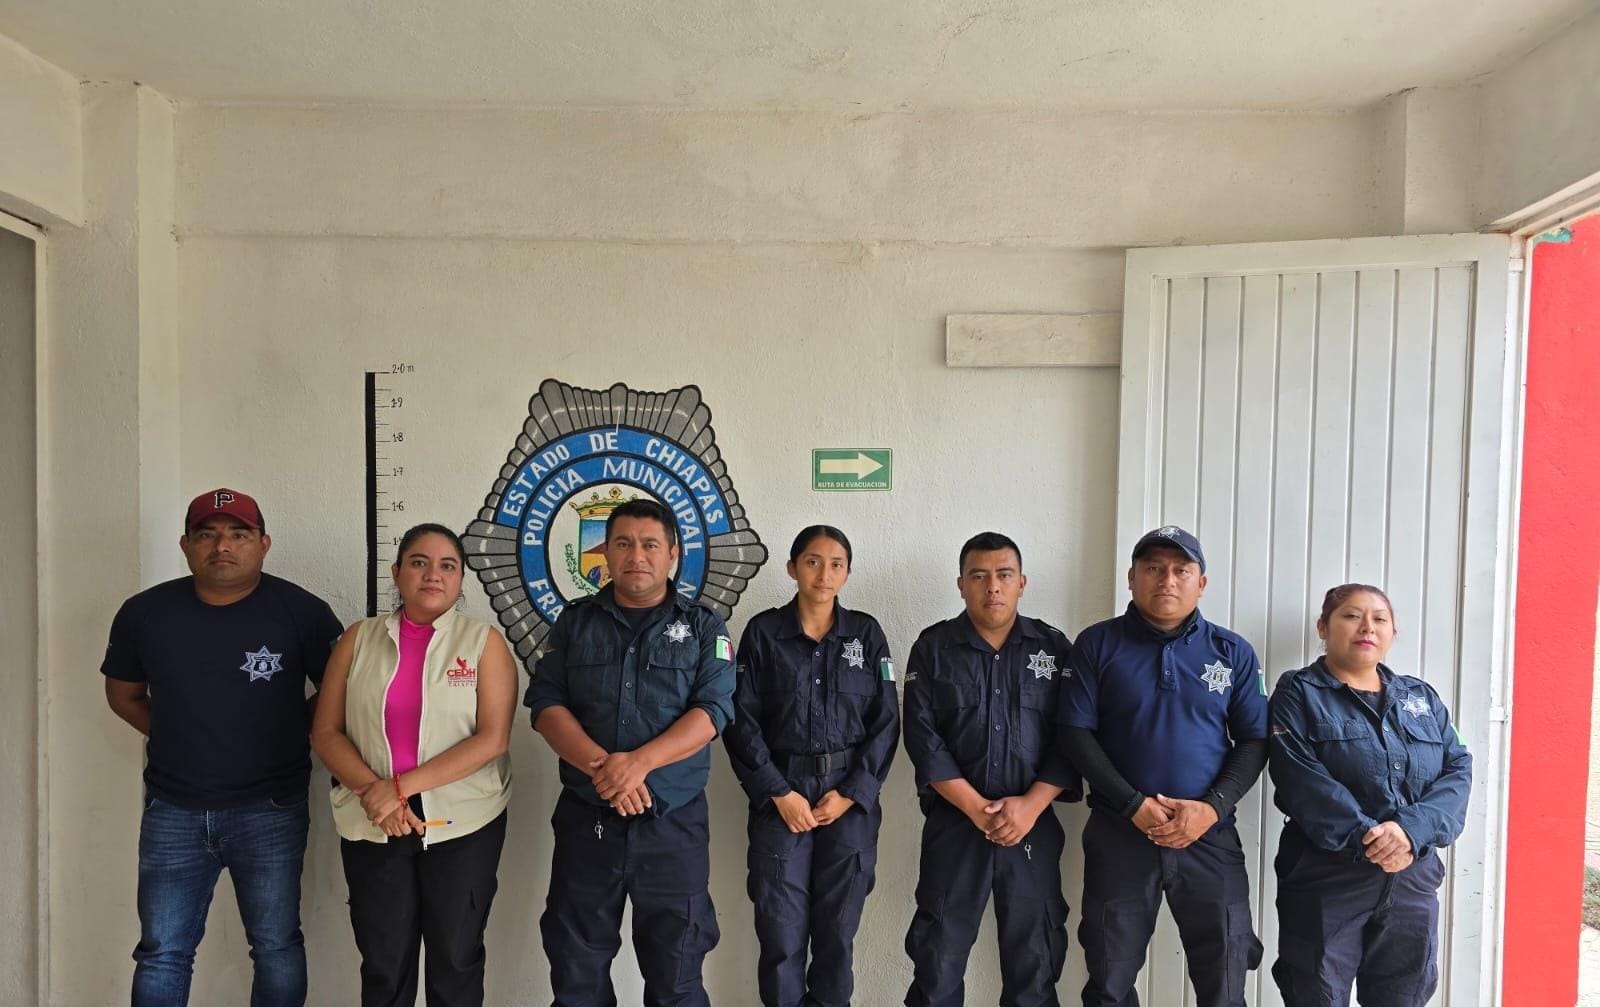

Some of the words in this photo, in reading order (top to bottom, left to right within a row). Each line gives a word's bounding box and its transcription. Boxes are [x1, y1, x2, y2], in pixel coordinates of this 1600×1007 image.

[214, 491, 235, 509] P
[502, 443, 571, 518] ESTADO
[589, 431, 619, 453] DE
[645, 438, 723, 524] CHIAPAS
[602, 457, 703, 556] MUNICIPAL
[446, 668, 476, 677] CEDH
